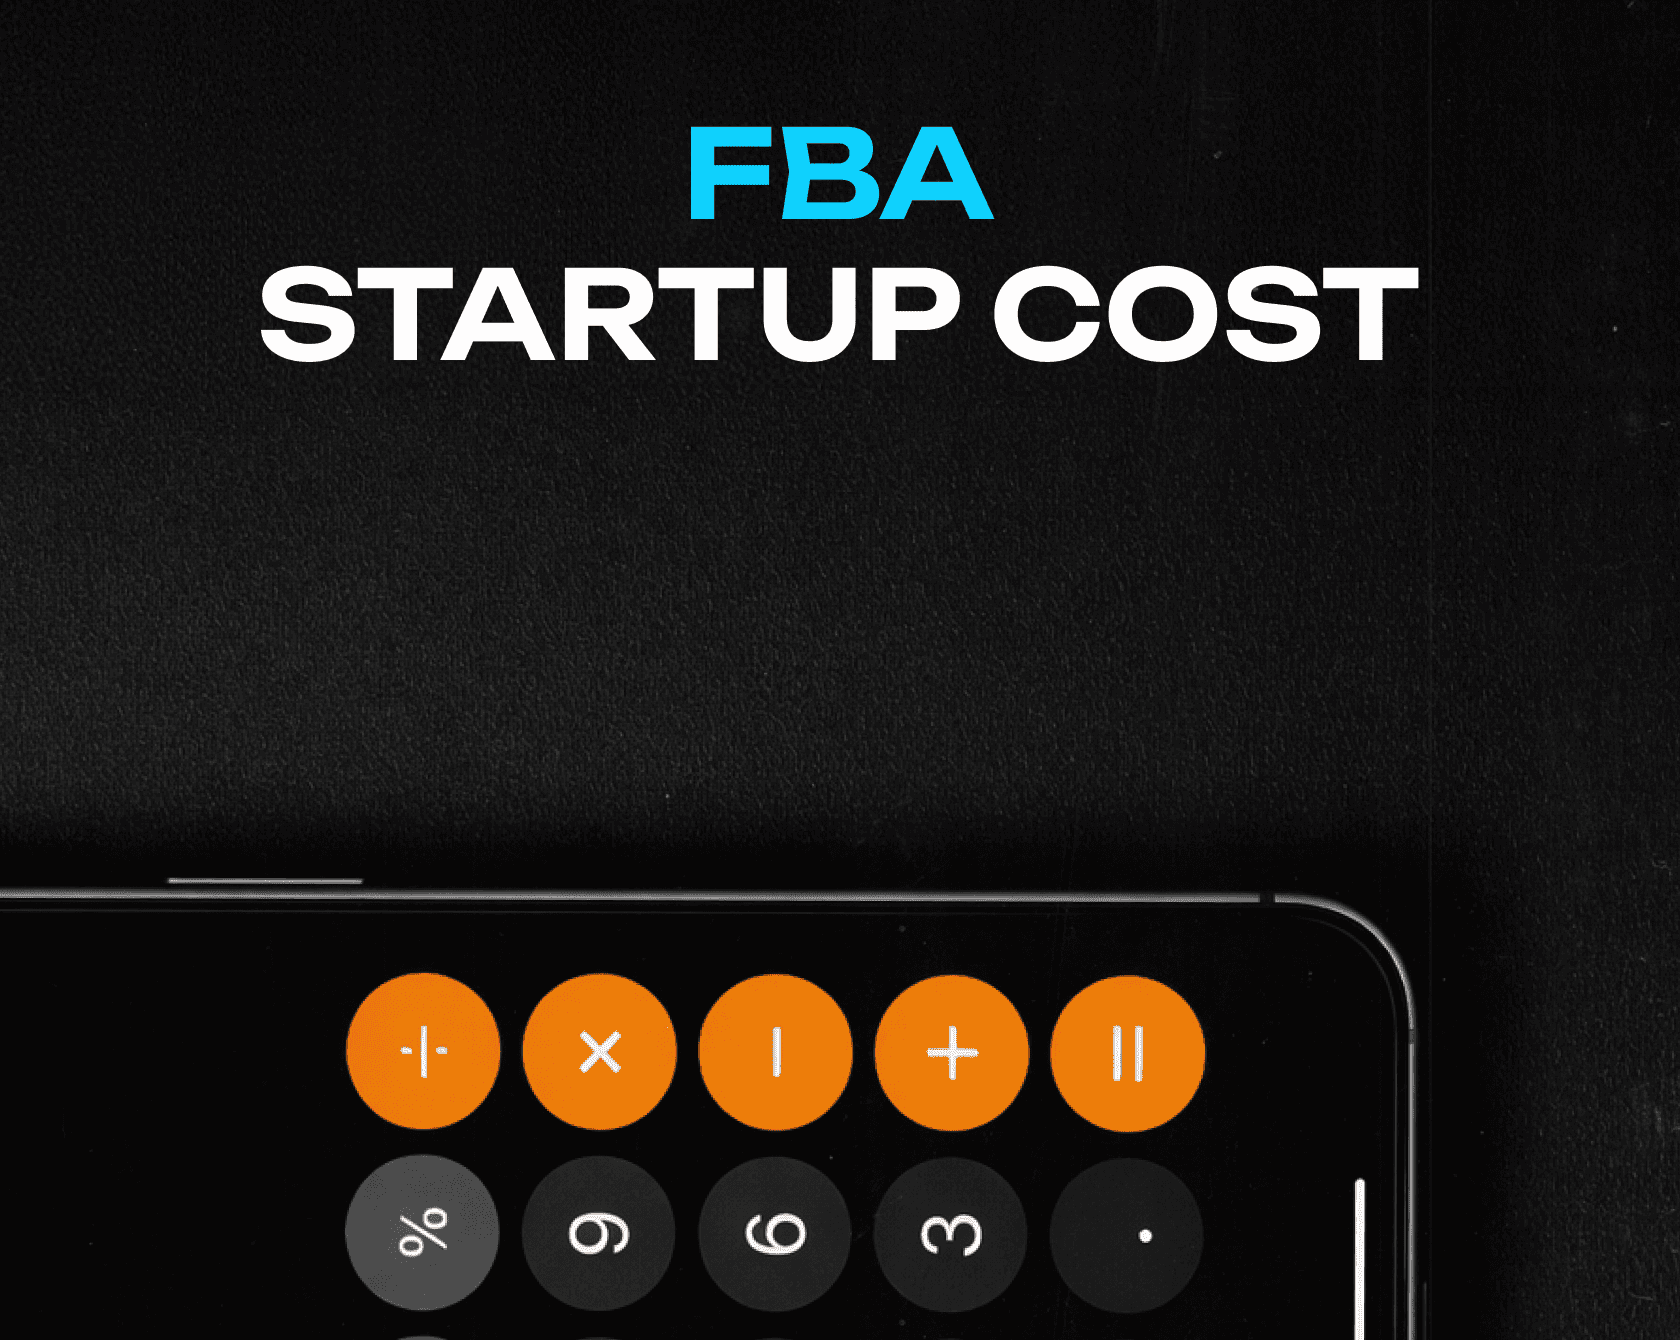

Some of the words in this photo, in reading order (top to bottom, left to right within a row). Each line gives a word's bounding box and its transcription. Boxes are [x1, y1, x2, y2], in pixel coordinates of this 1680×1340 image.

[398, 1207, 448, 1258] %
[568, 1212, 630, 1255] 9
[745, 1212, 806, 1256] 6
[920, 1213, 983, 1257] 3
